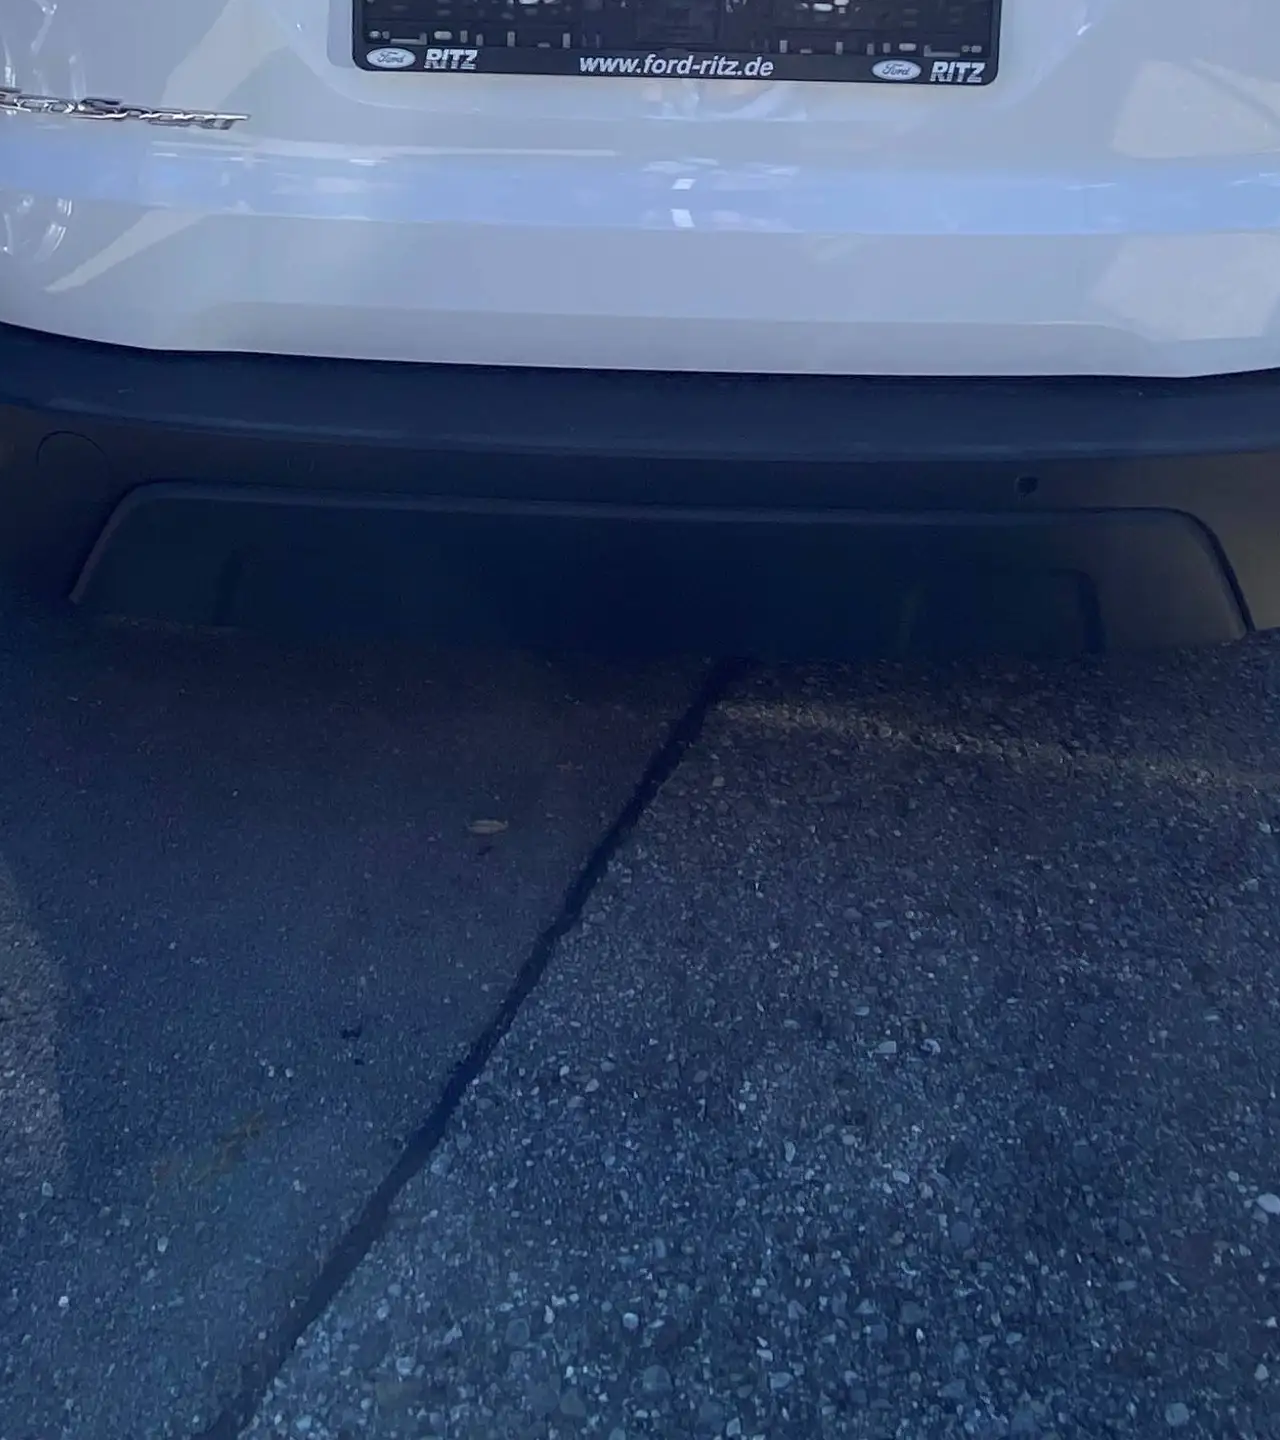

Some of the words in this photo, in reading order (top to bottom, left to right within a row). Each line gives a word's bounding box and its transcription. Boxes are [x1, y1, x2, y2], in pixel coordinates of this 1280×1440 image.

[423, 48, 479, 71] RITZ
[579, 53, 774, 77] www.ford-ritz.de
[930, 61, 986, 83] RITZ
